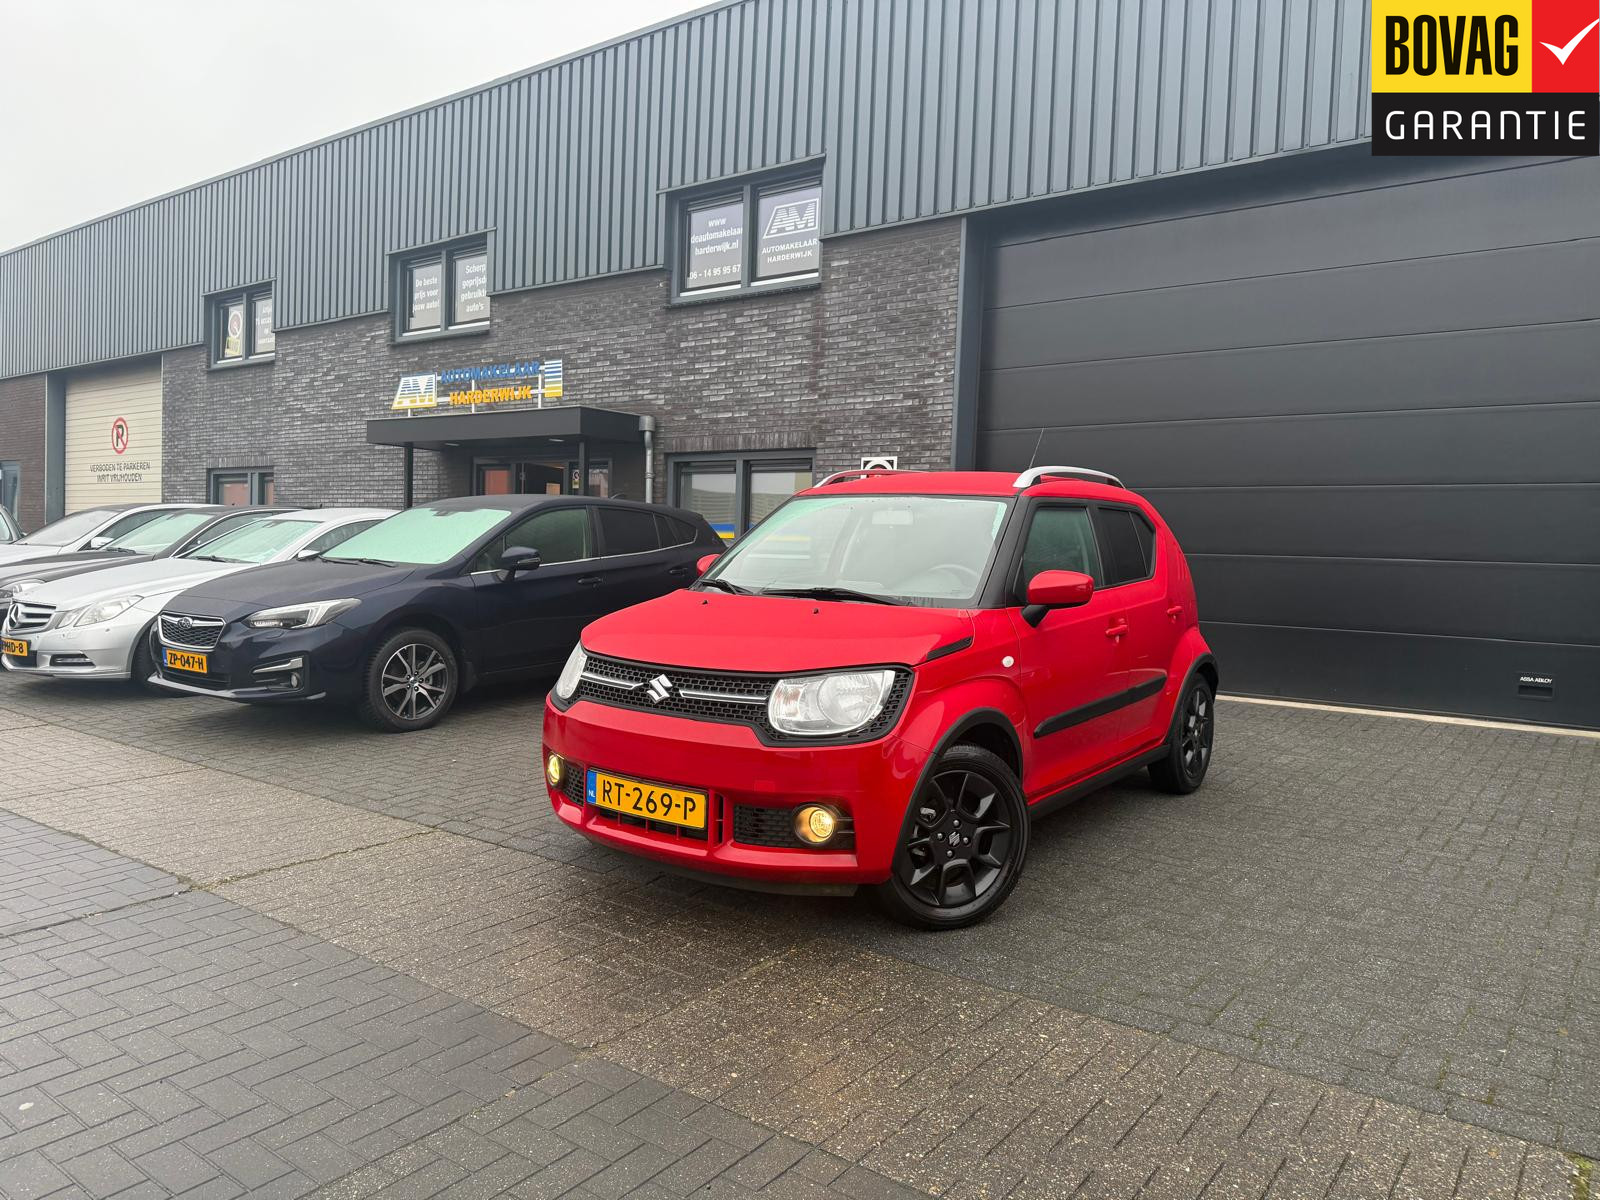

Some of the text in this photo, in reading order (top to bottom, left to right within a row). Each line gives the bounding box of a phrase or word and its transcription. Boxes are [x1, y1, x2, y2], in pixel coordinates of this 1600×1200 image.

[694, 240, 739, 256] harderwijk.nl
[762, 238, 818, 255] AUTOMAKELAAR
[767, 249, 813, 264] HARDERWIJK
[704, 268, 711, 278] 14
[441, 360, 540, 385] AUTOMAKELAAR
[449, 385, 532, 405] HARDERWIJK
[90, 461, 151, 473] VERBODEN TE PARKEREN
[168, 652, 204, 671] ZP-047-H
[588, 789, 596, 798] NL
[602, 779, 697, 820] RT-269-P
